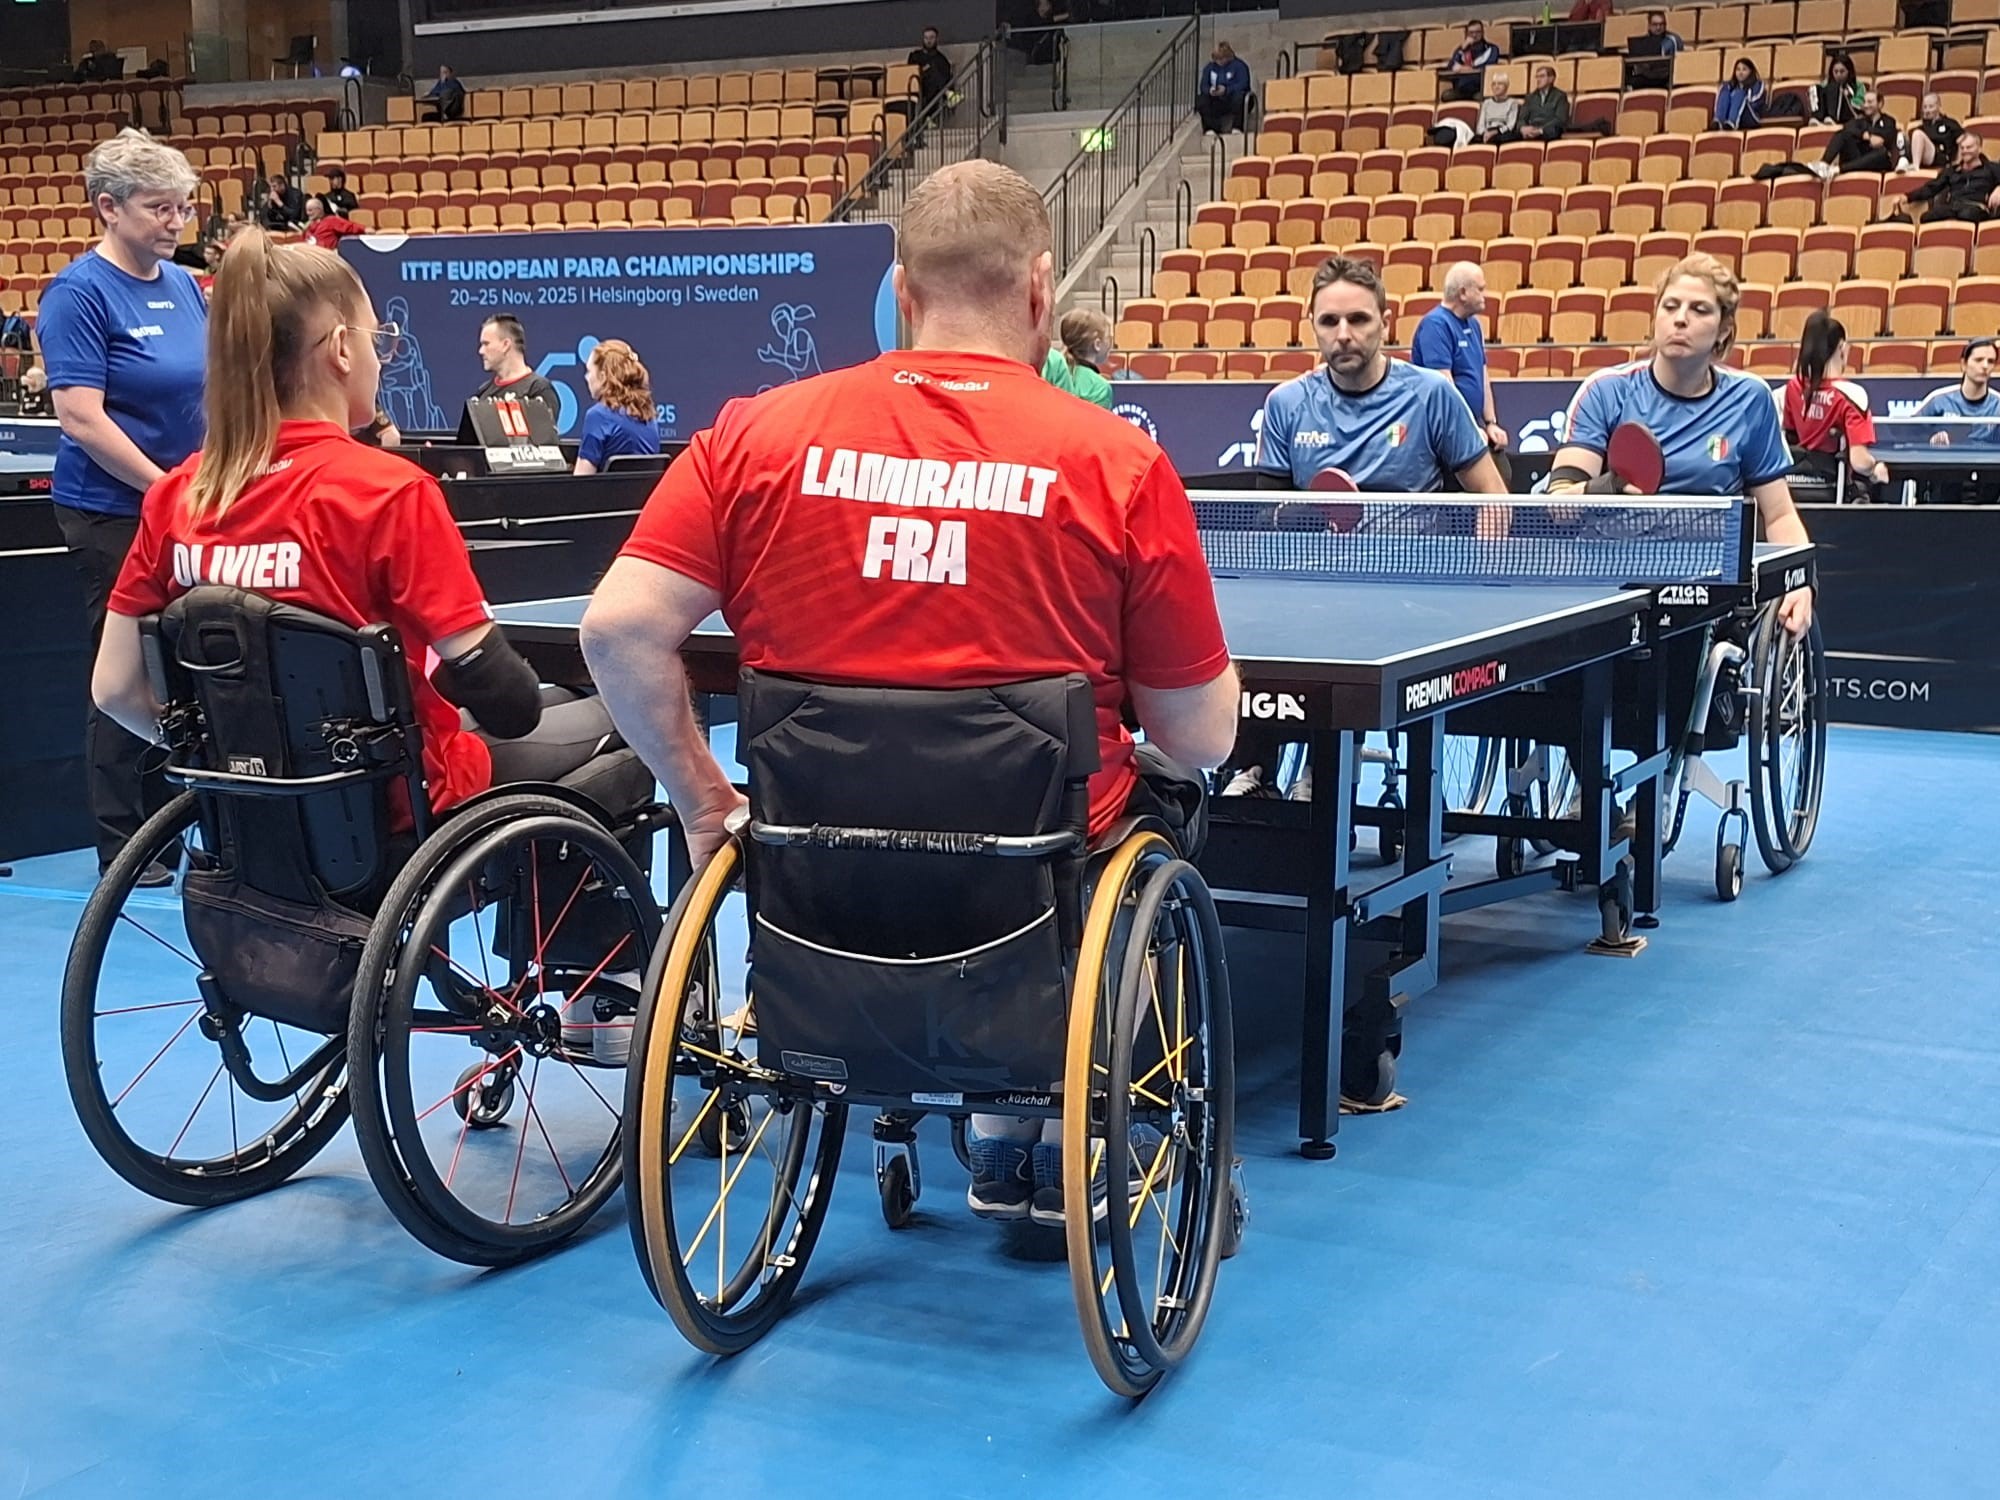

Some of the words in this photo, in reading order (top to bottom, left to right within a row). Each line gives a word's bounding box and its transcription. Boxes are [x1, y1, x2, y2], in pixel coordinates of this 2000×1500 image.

[402, 261, 442, 281] ITTF
[447, 258, 559, 280] EUROPEAN
[564, 256, 621, 278] PARA
[625, 252, 815, 277] CHAMPIONSHIPS
[502, 288, 534, 306] Nov,
[538, 287, 577, 304] 2025
[589, 285, 682, 306] Helsingborg
[694, 284, 759, 302] Sweden
[656, 404, 676, 423] 25
[801, 445, 1058, 518] LAMIRAULT
[173, 541, 301, 588] OLIVIER
[861, 516, 967, 585] FRA
[1406, 673, 1453, 712] PREMIUM
[1453, 660, 1499, 697] COMPACT
[1498, 663, 1507, 682] W
[1241, 691, 1306, 720] IGA
